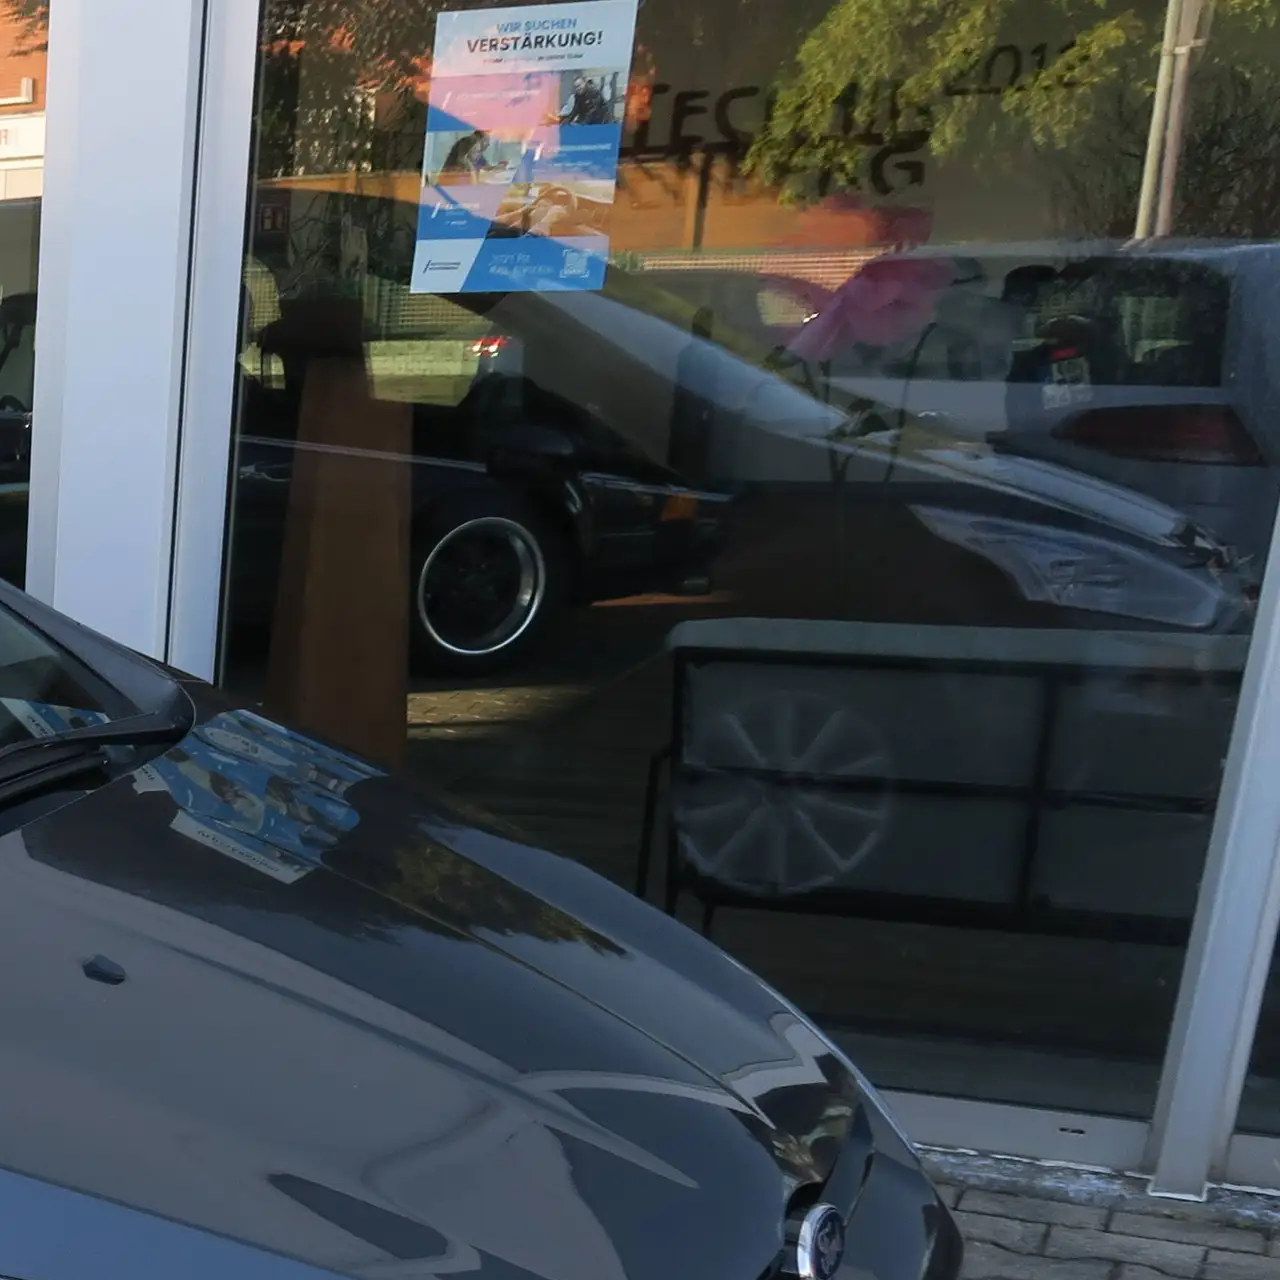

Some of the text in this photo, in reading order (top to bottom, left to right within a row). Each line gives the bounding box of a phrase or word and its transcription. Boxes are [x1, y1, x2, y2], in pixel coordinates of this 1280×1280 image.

[496, 18, 578, 34] WIR SUCHEN
[467, 31, 604, 53] VERSTÄRKUNG!
